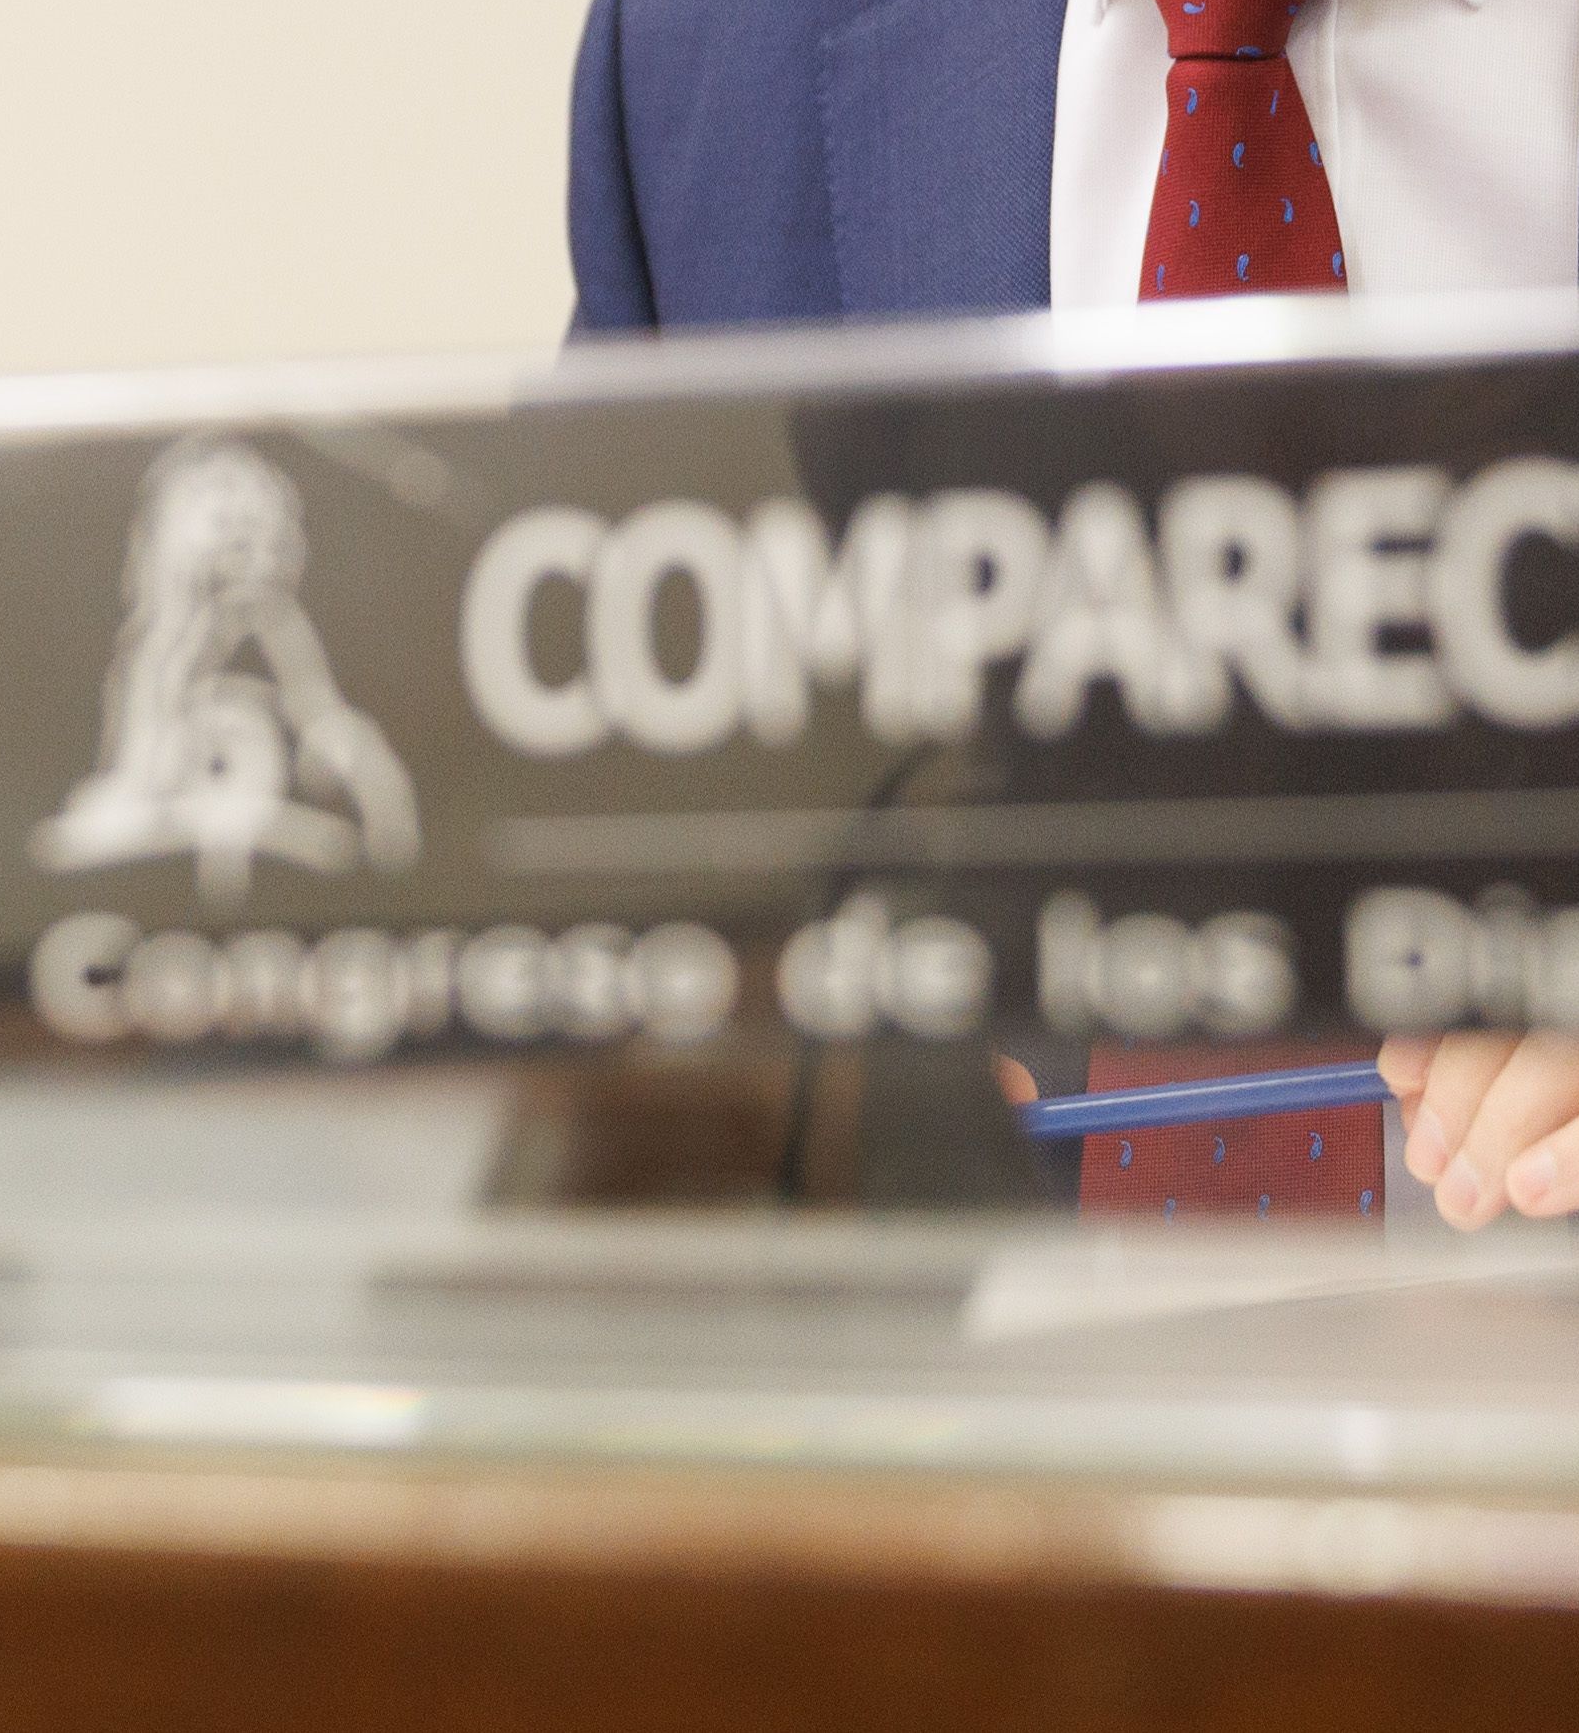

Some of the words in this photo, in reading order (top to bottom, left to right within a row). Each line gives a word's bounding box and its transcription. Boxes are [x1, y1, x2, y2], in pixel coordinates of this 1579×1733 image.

[29, 909, 738, 1059] Congreso
[778, 886, 991, 1044] de
[1036, 888, 1293, 1041] los
